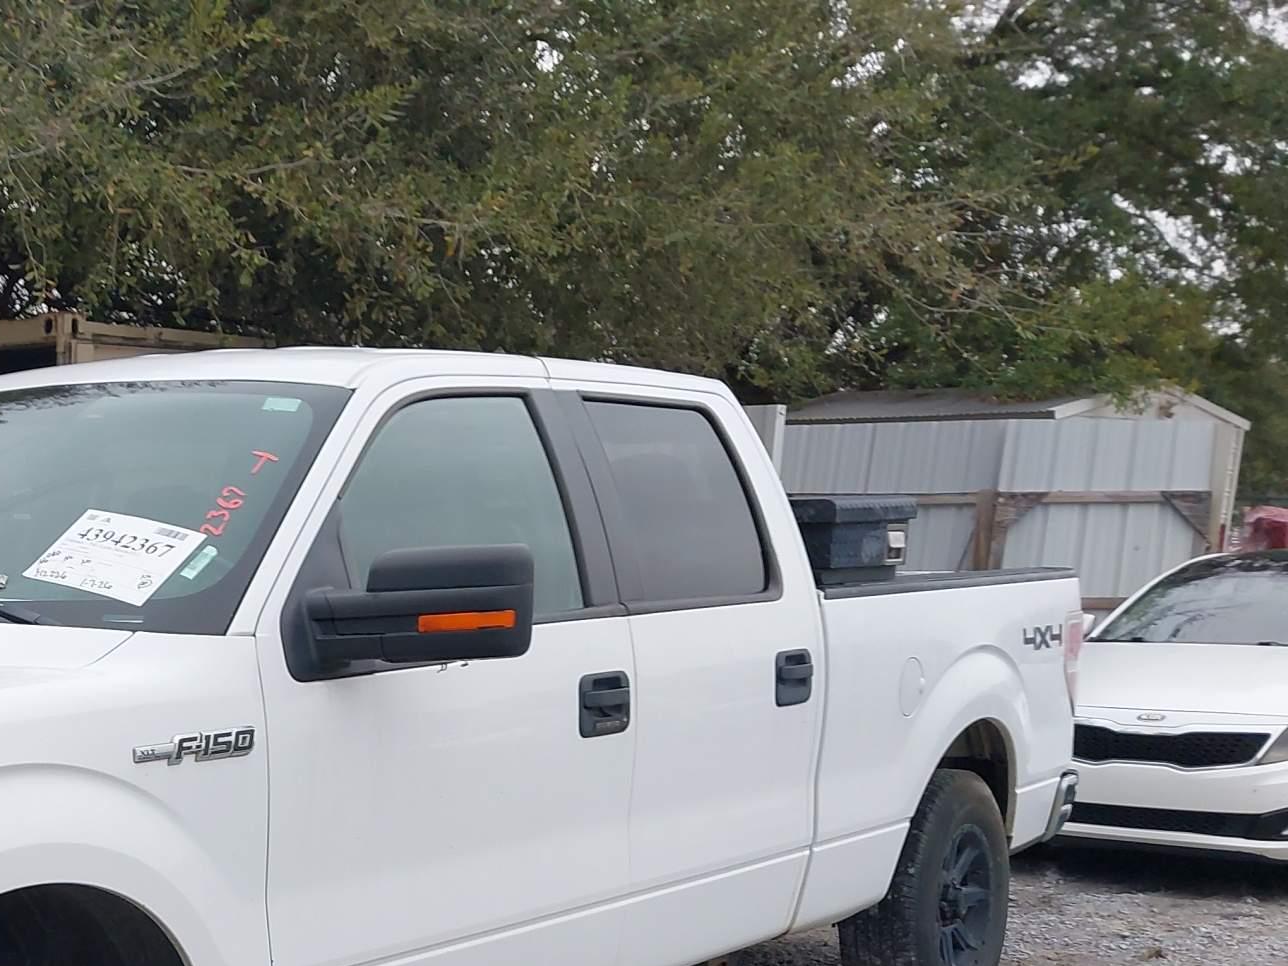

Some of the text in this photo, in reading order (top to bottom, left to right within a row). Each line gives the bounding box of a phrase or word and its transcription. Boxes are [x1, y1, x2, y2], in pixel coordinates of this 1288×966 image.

[250, 449, 280, 475] T
[77, 526, 176, 558] 43942367
[170, 726, 257, 764] F-150
